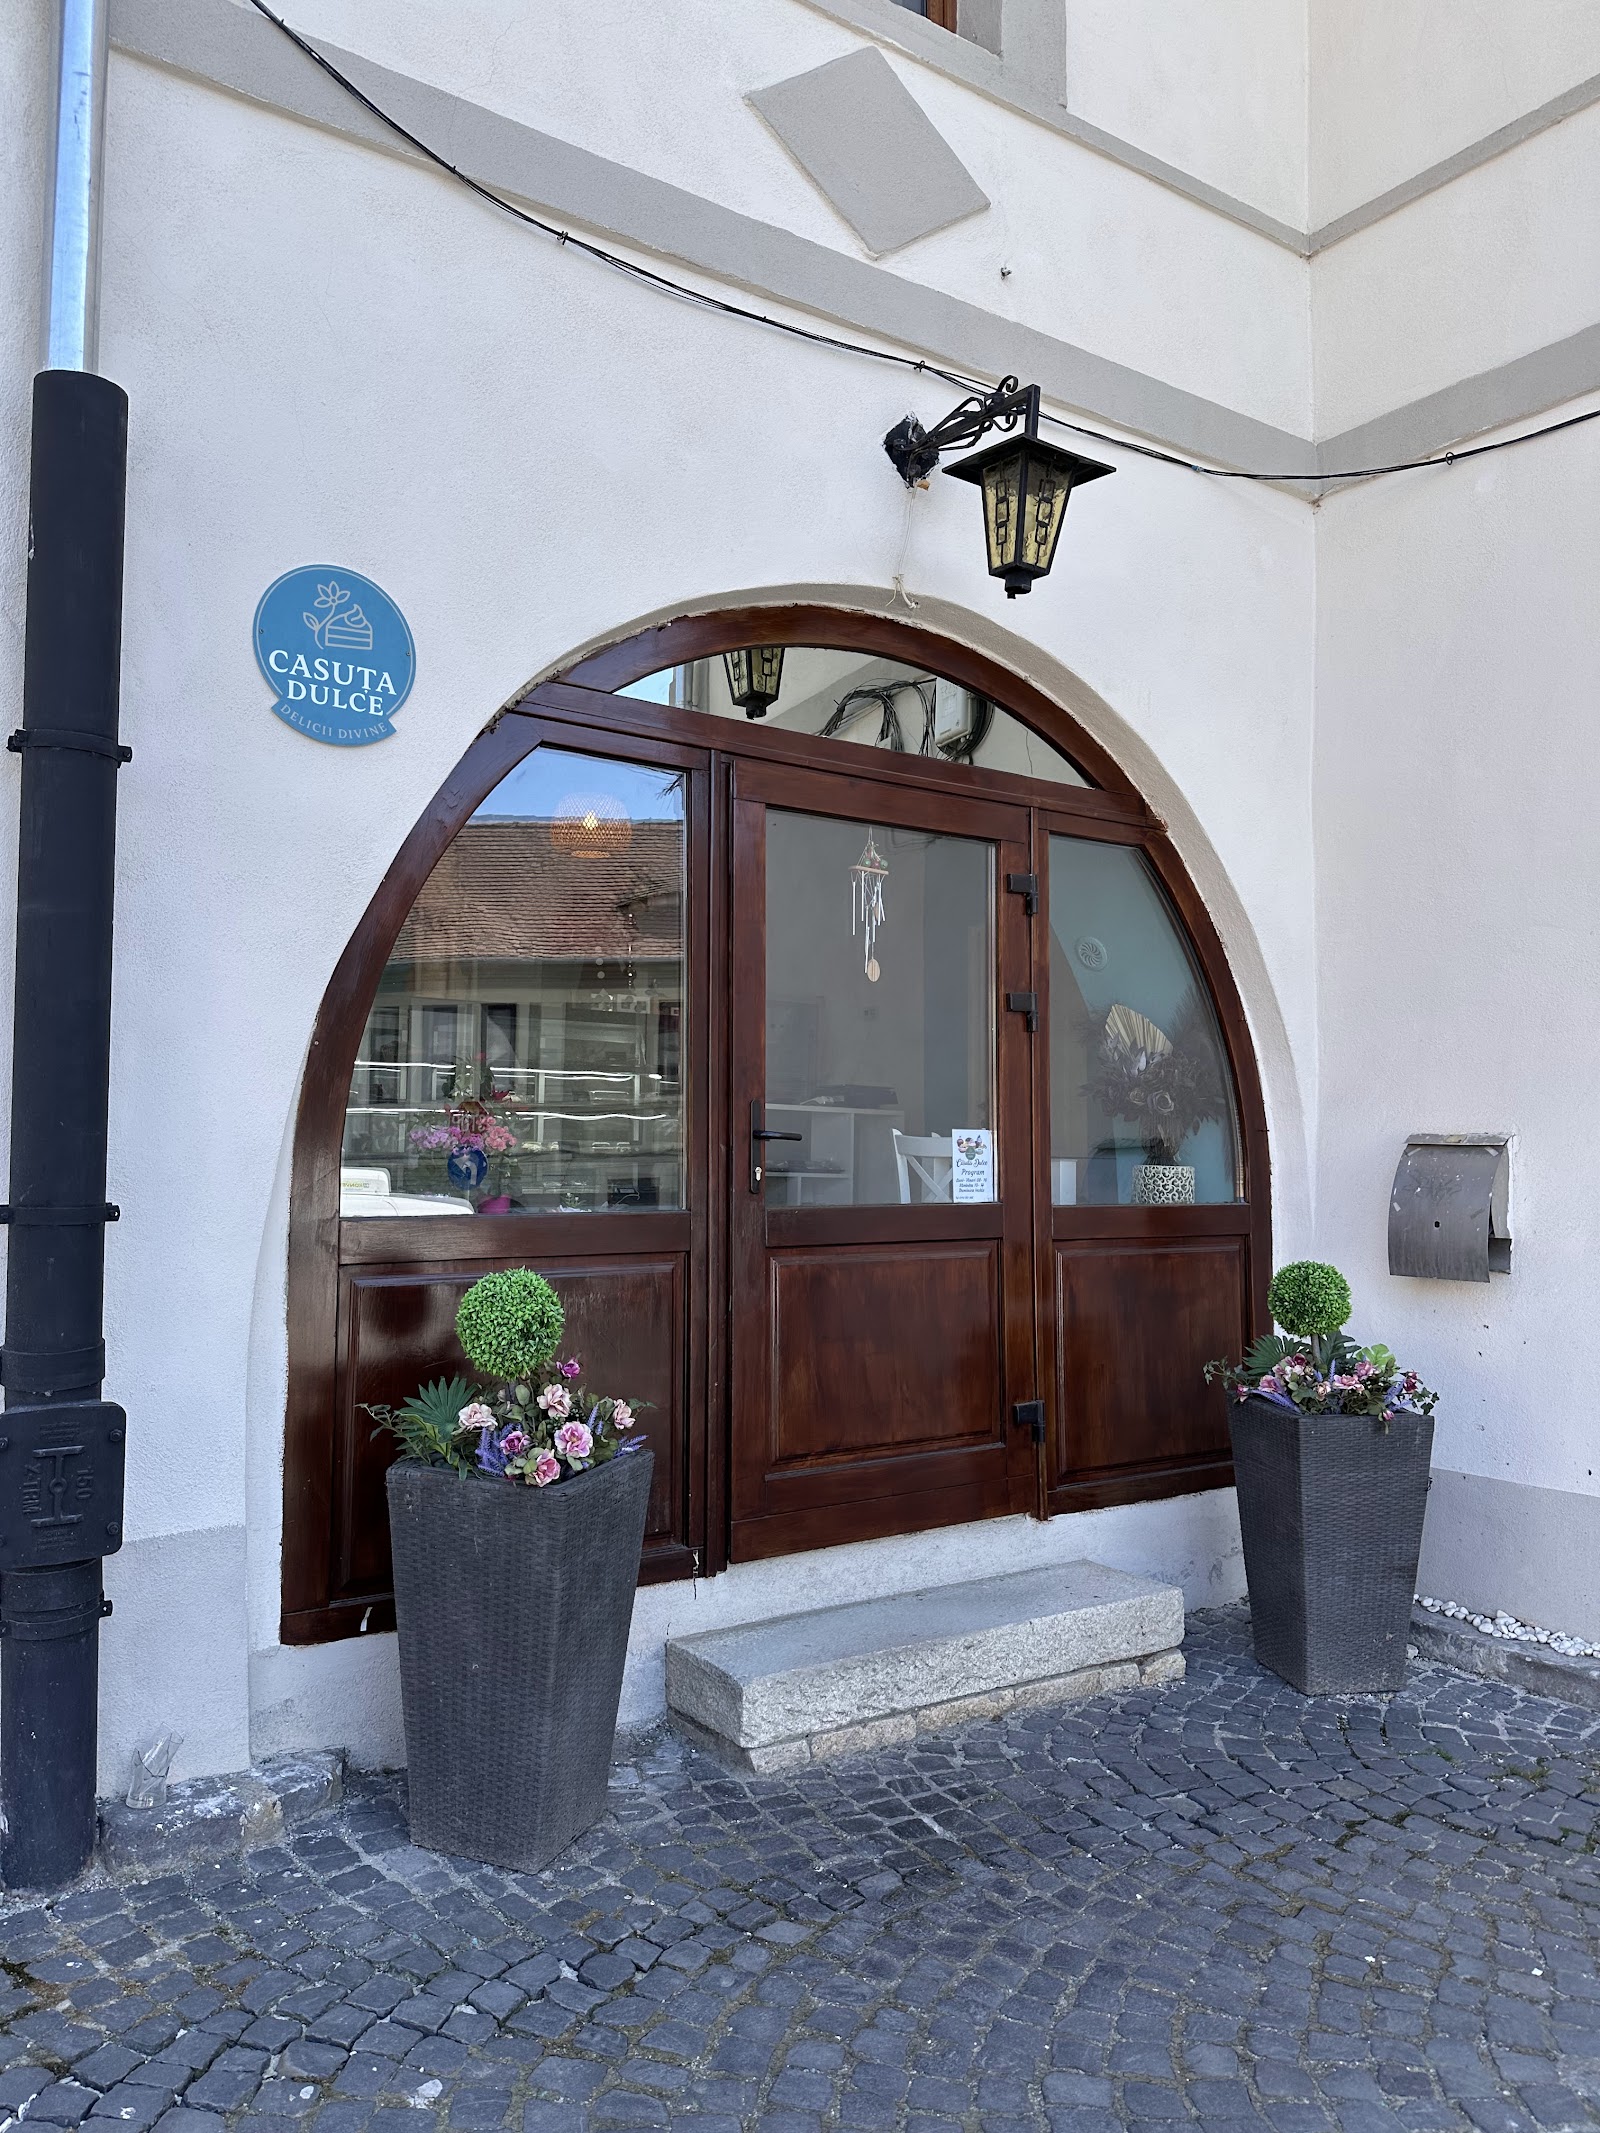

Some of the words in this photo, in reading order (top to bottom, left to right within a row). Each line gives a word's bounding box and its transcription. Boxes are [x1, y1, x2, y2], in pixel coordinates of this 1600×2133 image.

[287, 679, 383, 716] DULCE
[280, 703, 332, 737] DELICII
[338, 722, 387, 739] DIVINE
[961, 1168, 985, 1177] Program
